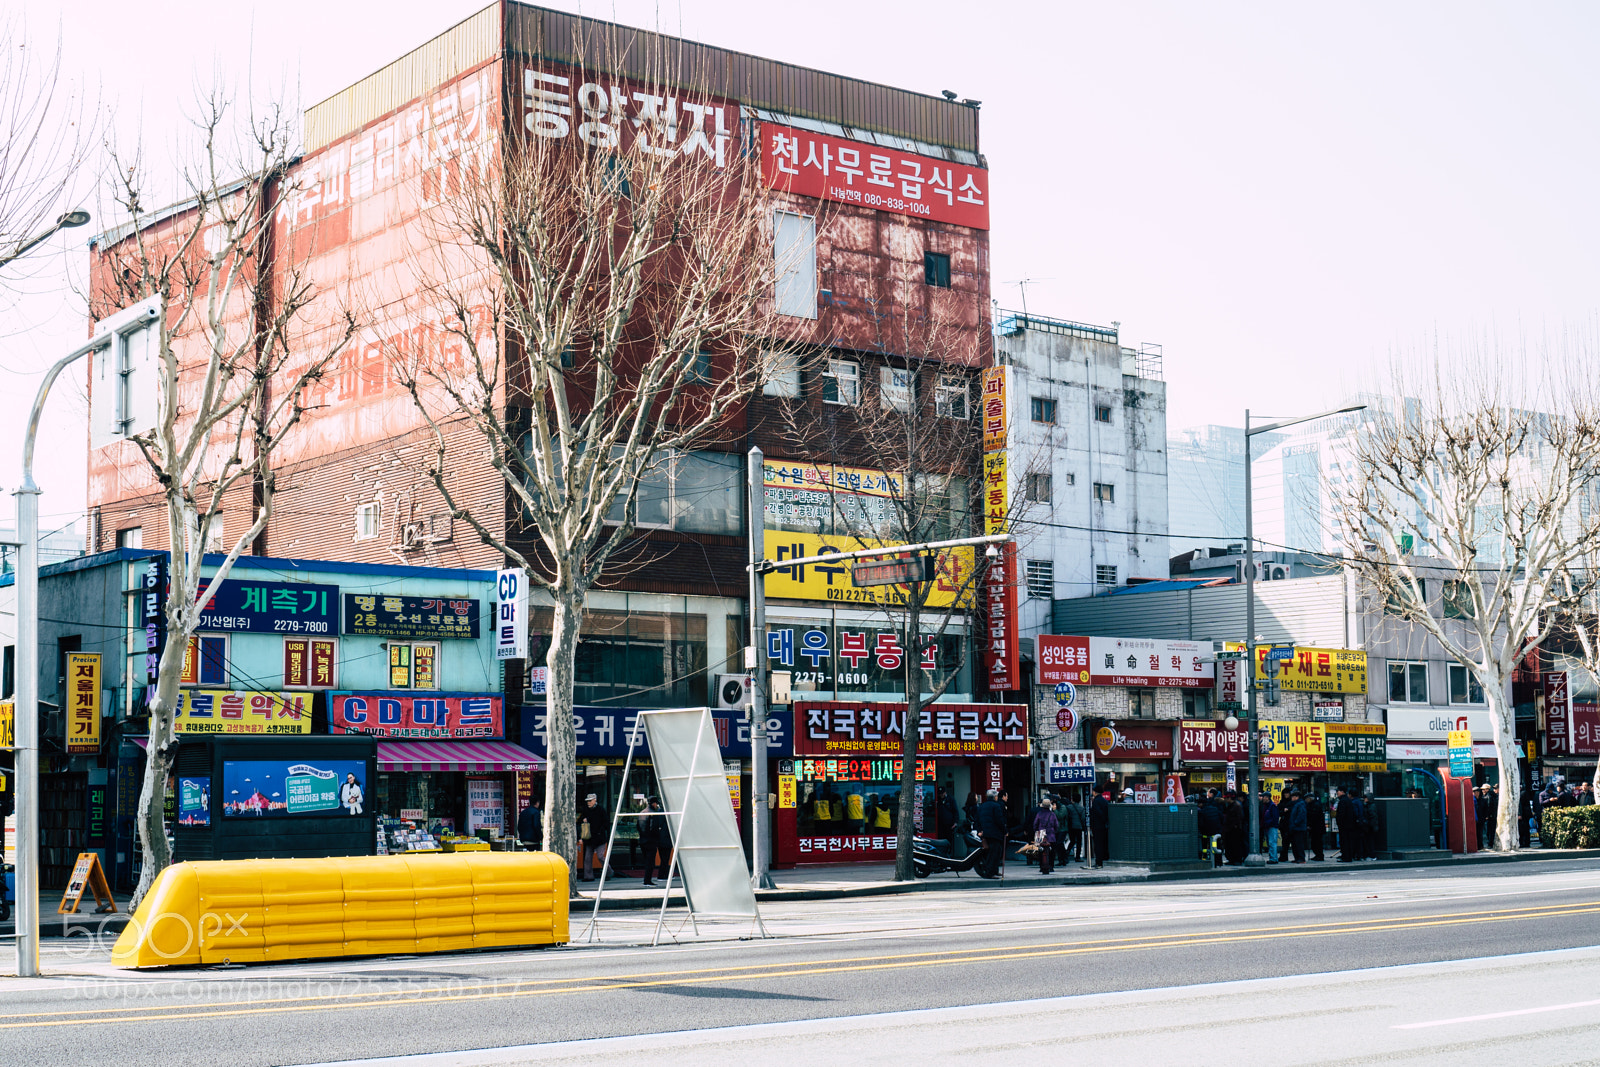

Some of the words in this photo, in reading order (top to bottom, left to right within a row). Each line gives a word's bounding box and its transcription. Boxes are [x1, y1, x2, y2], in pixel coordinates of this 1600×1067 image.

[771, 132, 985, 206] 천사무료급식소
[830, 186, 862, 202] 나눔전화
[864, 193, 930, 215] 080-838-1004
[985, 377, 1004, 438] 파출부
[986, 457, 1004, 469] 대우
[988, 471, 1004, 524] 부동산
[769, 503, 793, 515] 간병인
[777, 542, 845, 585] 대우
[240, 587, 328, 616] 계측기
[354, 596, 404, 612] 명품
[421, 599, 472, 615] 가방
[499, 574, 518, 645] CD마트
[198, 615, 250, 629] 기산업(주)
[274, 619, 328, 632] 2279-7800
[354, 613, 377, 626] 2층
[394, 614, 422, 624] 수선
[427, 615, 469, 625] 전문점
[288, 643, 304, 651] USB
[416, 647, 433, 657] DVD
[839, 631, 938, 671] 부동산
[1042, 645, 1088, 666] 성인용품
[317, 655, 329, 683] 녹음기
[533, 669, 545, 680] 주은
[794, 671, 869, 685] 2275-4600
[1126, 677, 1149, 686] Healing
[1222, 660, 1237, 702] 당구재료
[75, 665, 94, 735] 저울계측기
[173, 694, 305, 721] 로음악사
[343, 696, 493, 726] CD마트
[1316, 707, 1342, 716] 한일기업
[1547, 674, 1566, 751] 두산의료기
[807, 708, 1025, 741] 전국천사무료급식소
[1429, 716, 1454, 731] olleh
[825, 740, 866, 751] 정부지원없이
[866, 741, 901, 751] 운영합니다
[918, 742, 946, 751] 나눔전화
[948, 743, 995, 752] 080-838-1004
[1181, 730, 1250, 753] 신세계이발관
[1295, 726, 1322, 752] 바둑
[1327, 736, 1346, 754] 동아
[1348, 737, 1385, 755] 의료과학
[1263, 757, 1287, 768] 한일기업
[1295, 757, 1324, 768] 2265-4261
[1053, 769, 1093, 779] 삼보당구재료
[783, 783, 792, 806] 부동산
[1265, 782, 1282, 792] 상패
[91, 790, 104, 837] 레코드
[799, 836, 898, 853] 전국천사무료급
